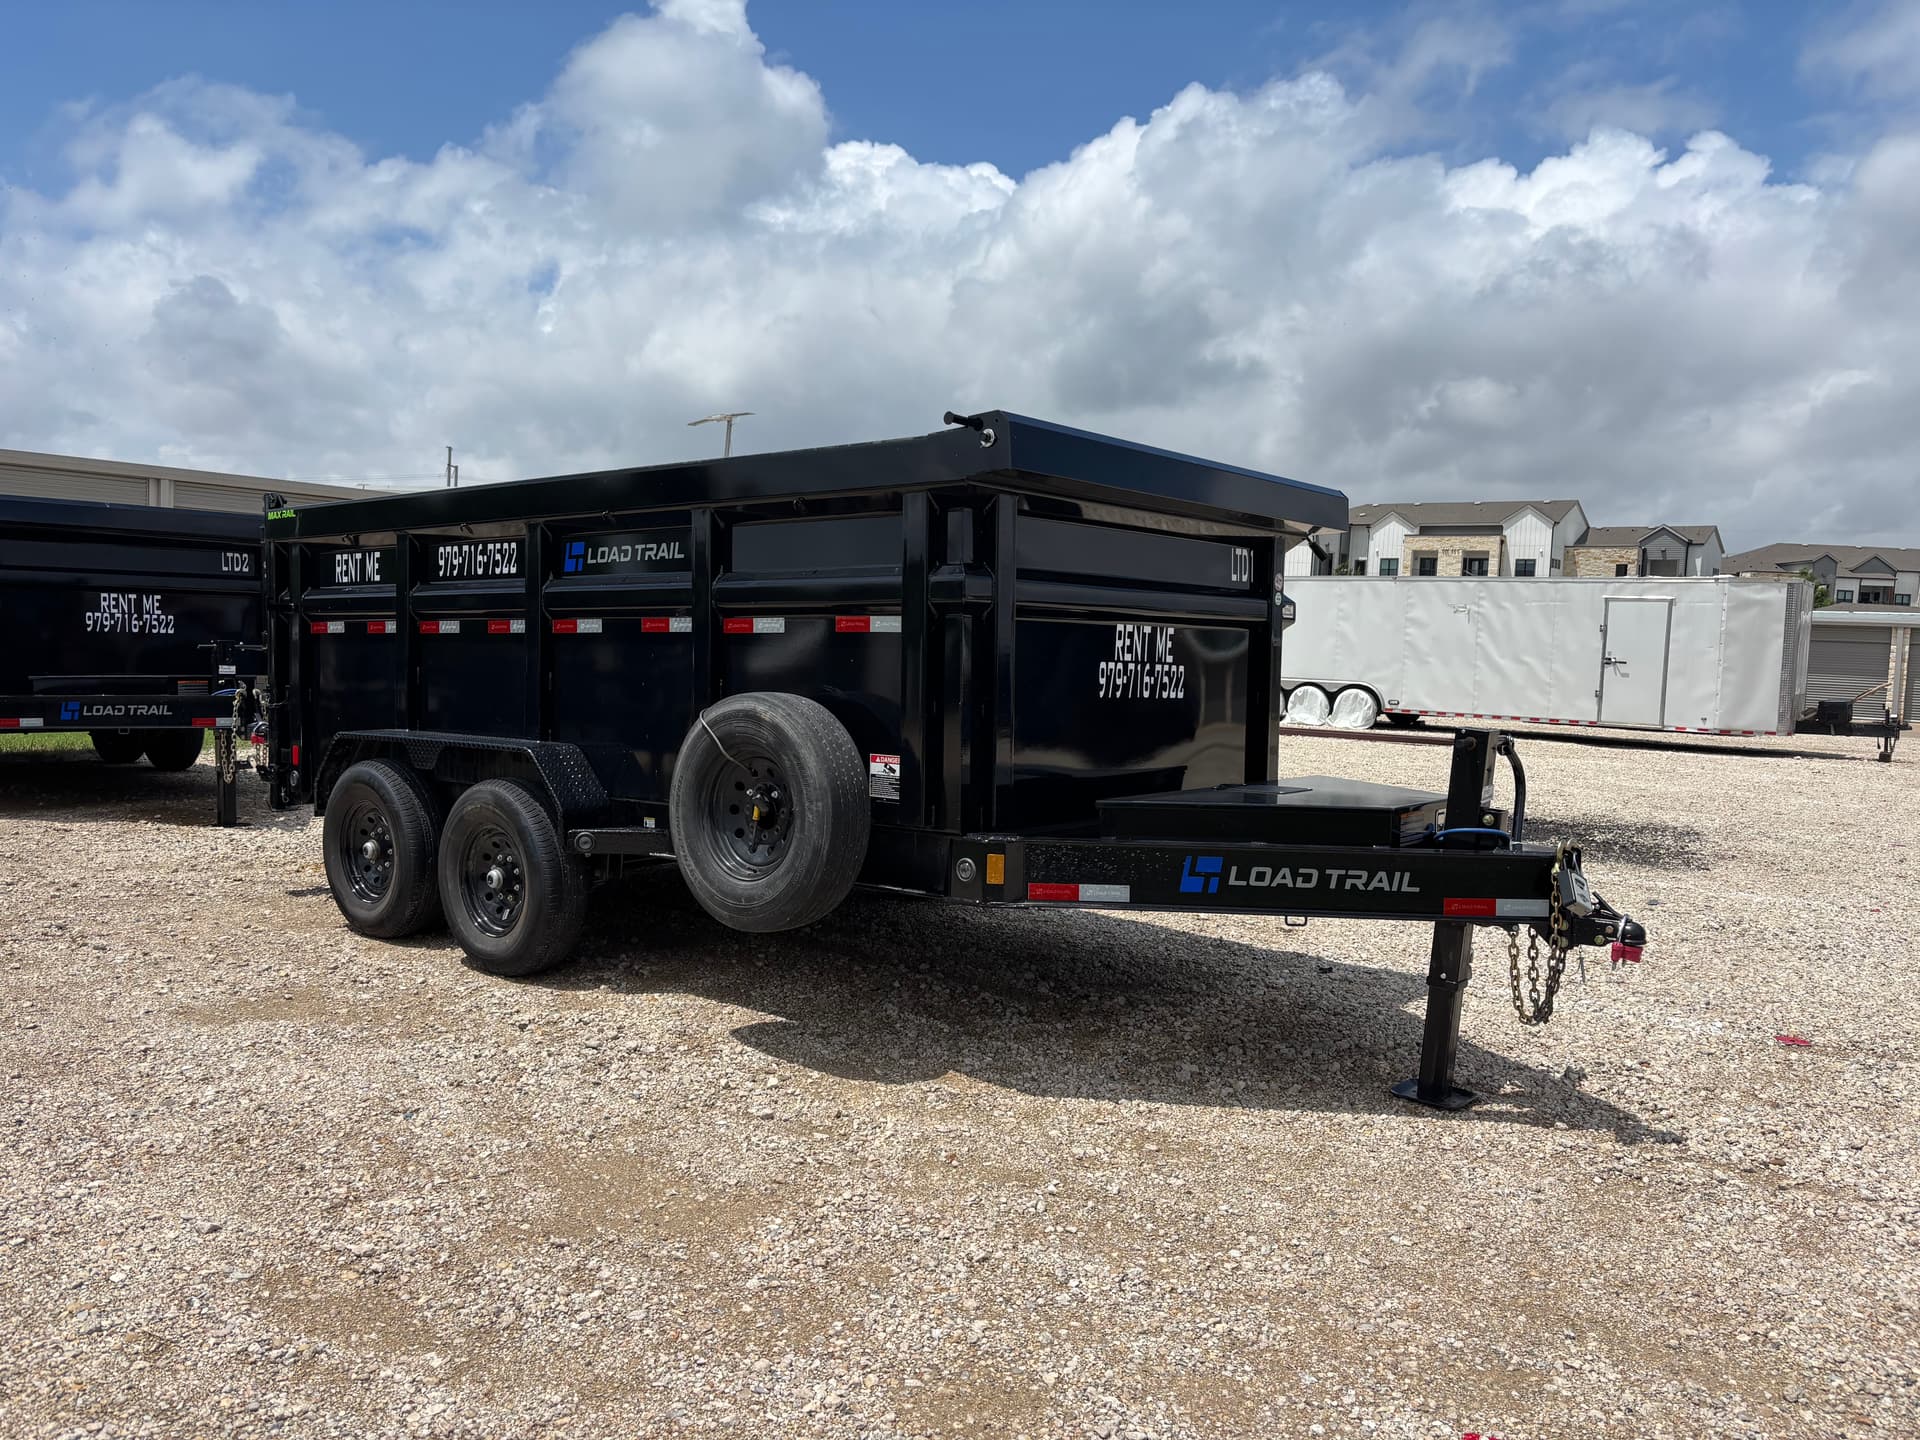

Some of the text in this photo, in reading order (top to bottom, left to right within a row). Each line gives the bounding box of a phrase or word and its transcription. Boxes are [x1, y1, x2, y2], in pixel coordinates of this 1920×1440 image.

[267, 509, 296, 520] MAX RAIL
[221, 552, 249, 572] LTD2
[438, 542, 517, 577] 979-716-7522
[587, 541, 685, 564] LOAD TRAIL
[335, 551, 381, 583] RENT ME
[1231, 548, 1254, 583] LTD1
[100, 593, 162, 615] RENT ME
[85, 612, 175, 634] 979-716-7522
[1114, 623, 1175, 663] RENT ME
[1098, 661, 1185, 699] 979-716-7522
[83, 705, 173, 716] LOAD TRAIL
[1228, 866, 1420, 893] LOAD TRAIL
